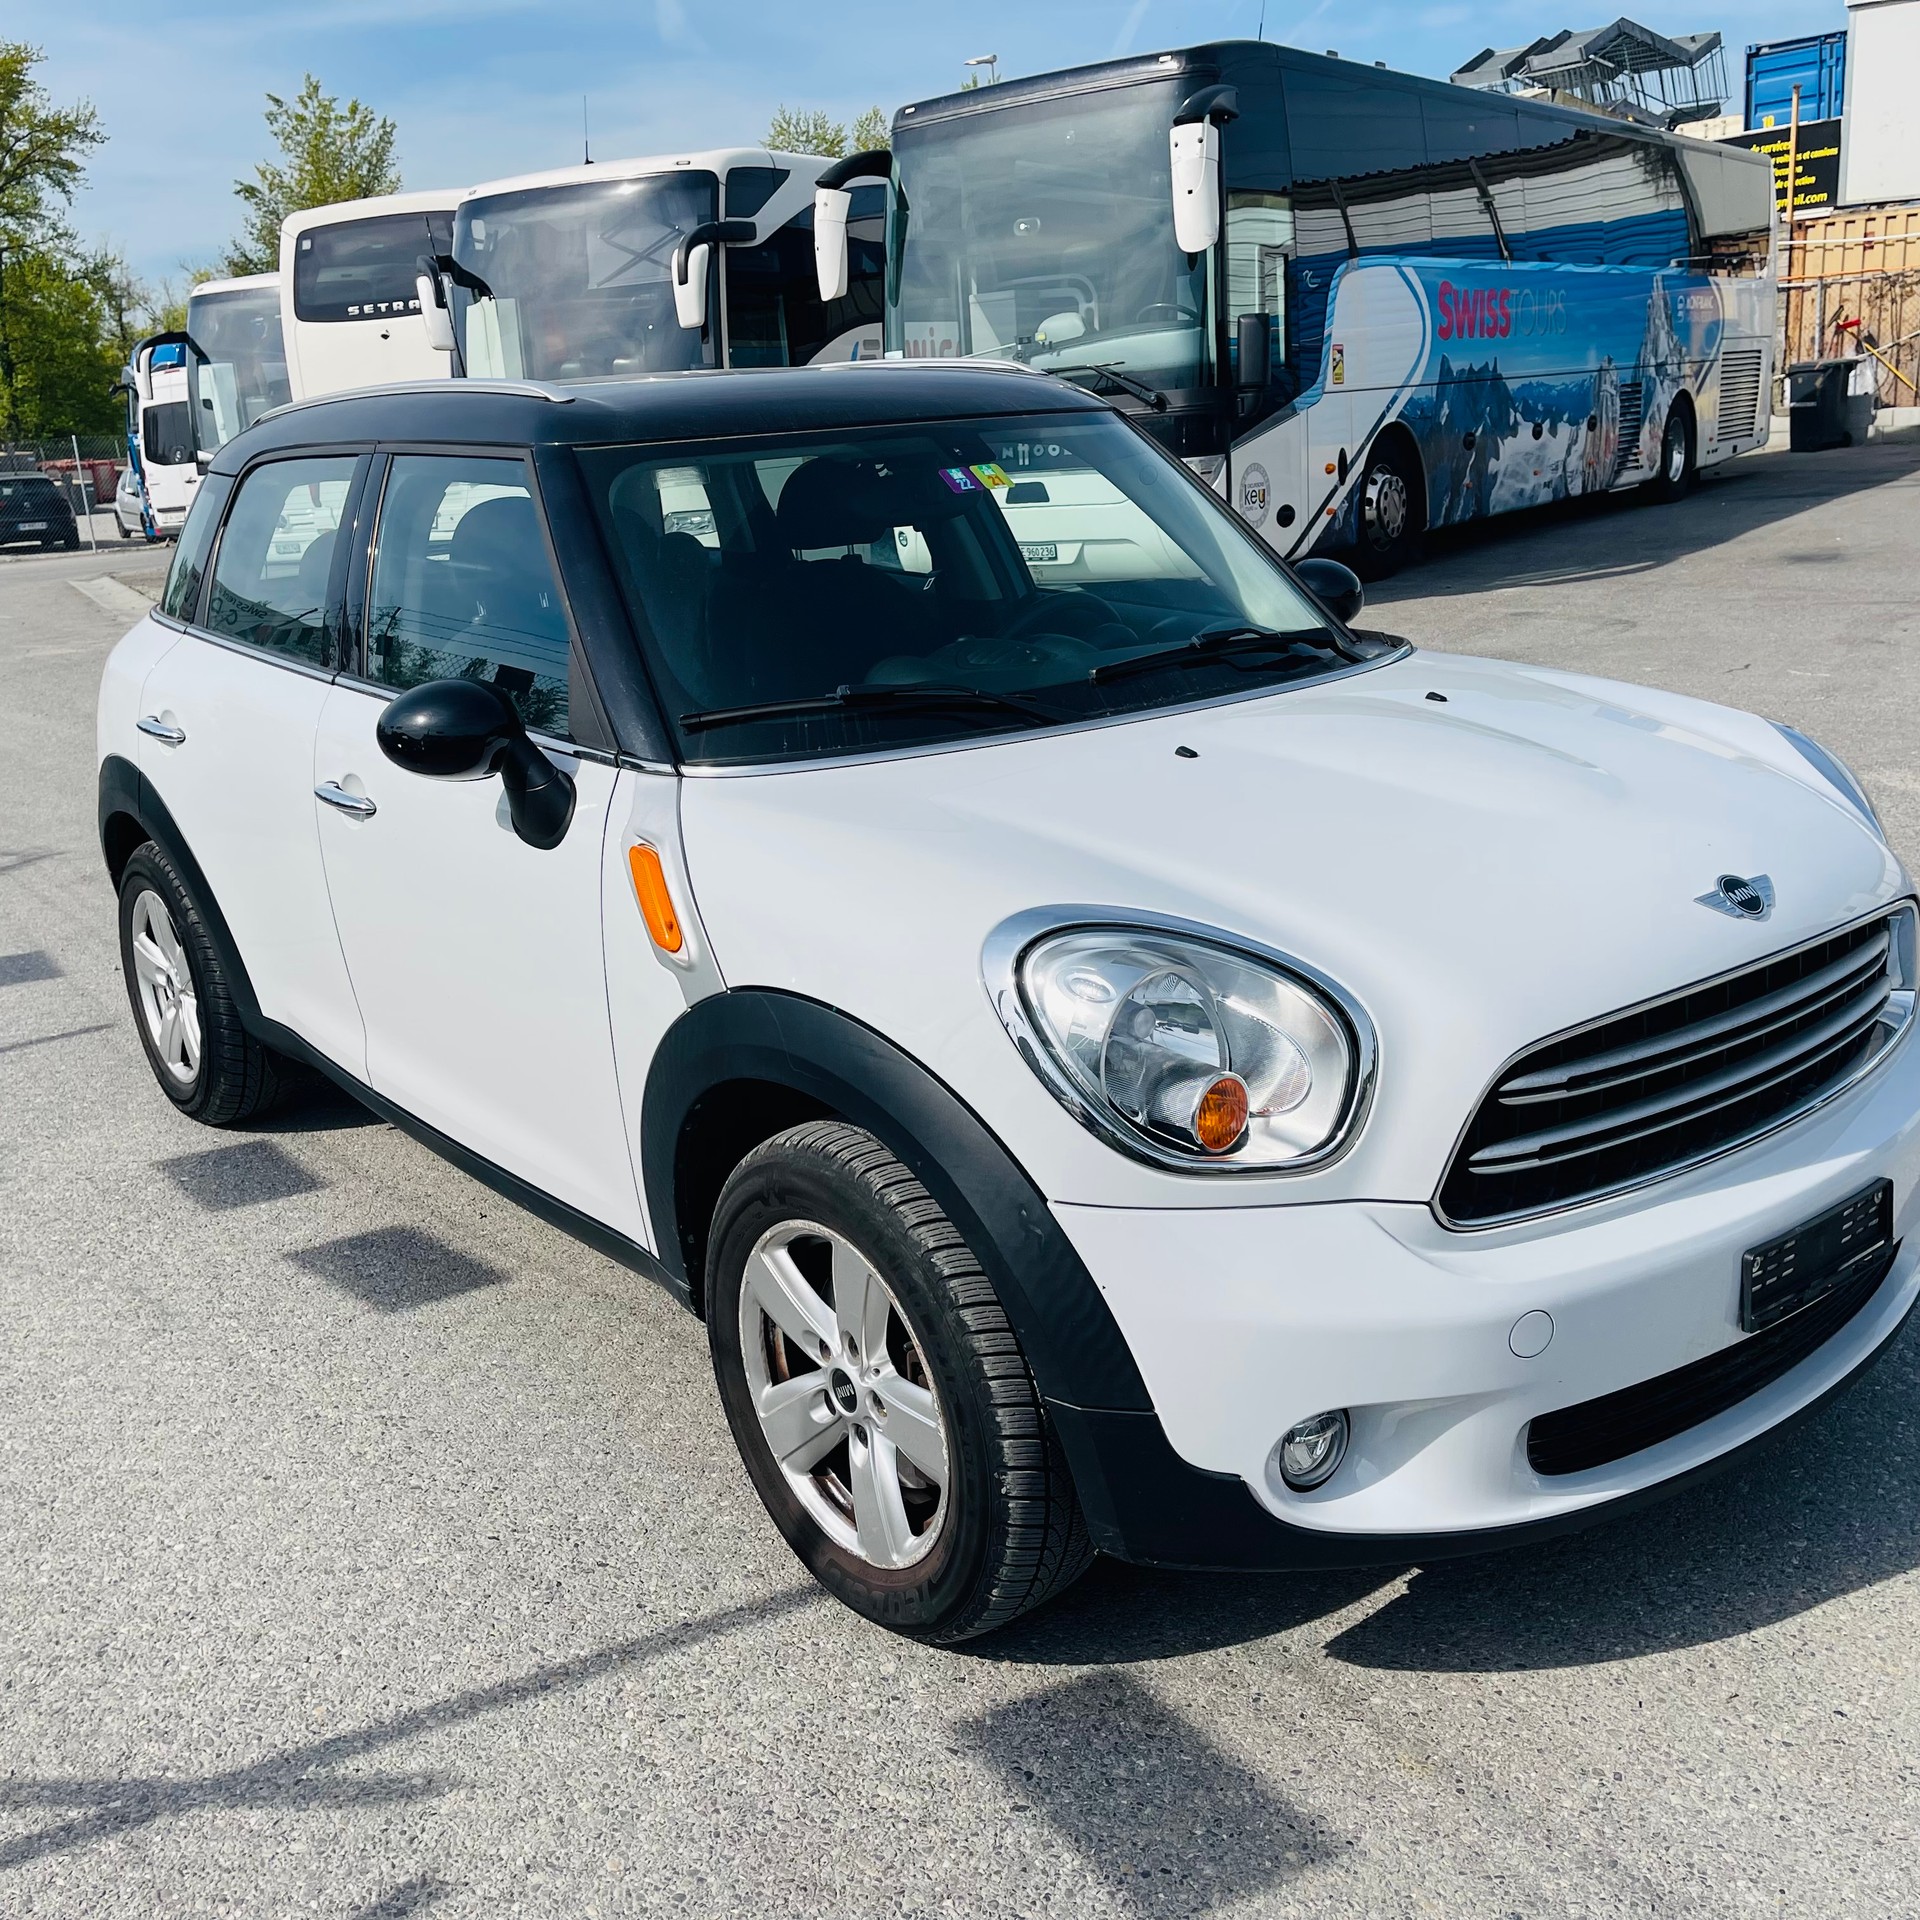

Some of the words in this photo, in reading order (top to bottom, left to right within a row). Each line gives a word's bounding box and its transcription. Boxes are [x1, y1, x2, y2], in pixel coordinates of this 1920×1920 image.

[347, 299, 420, 316] SETRA
[1244, 483, 1266, 510] key
[1728, 885, 1758, 903] MINI
[835, 1383, 855, 1399] MINI
